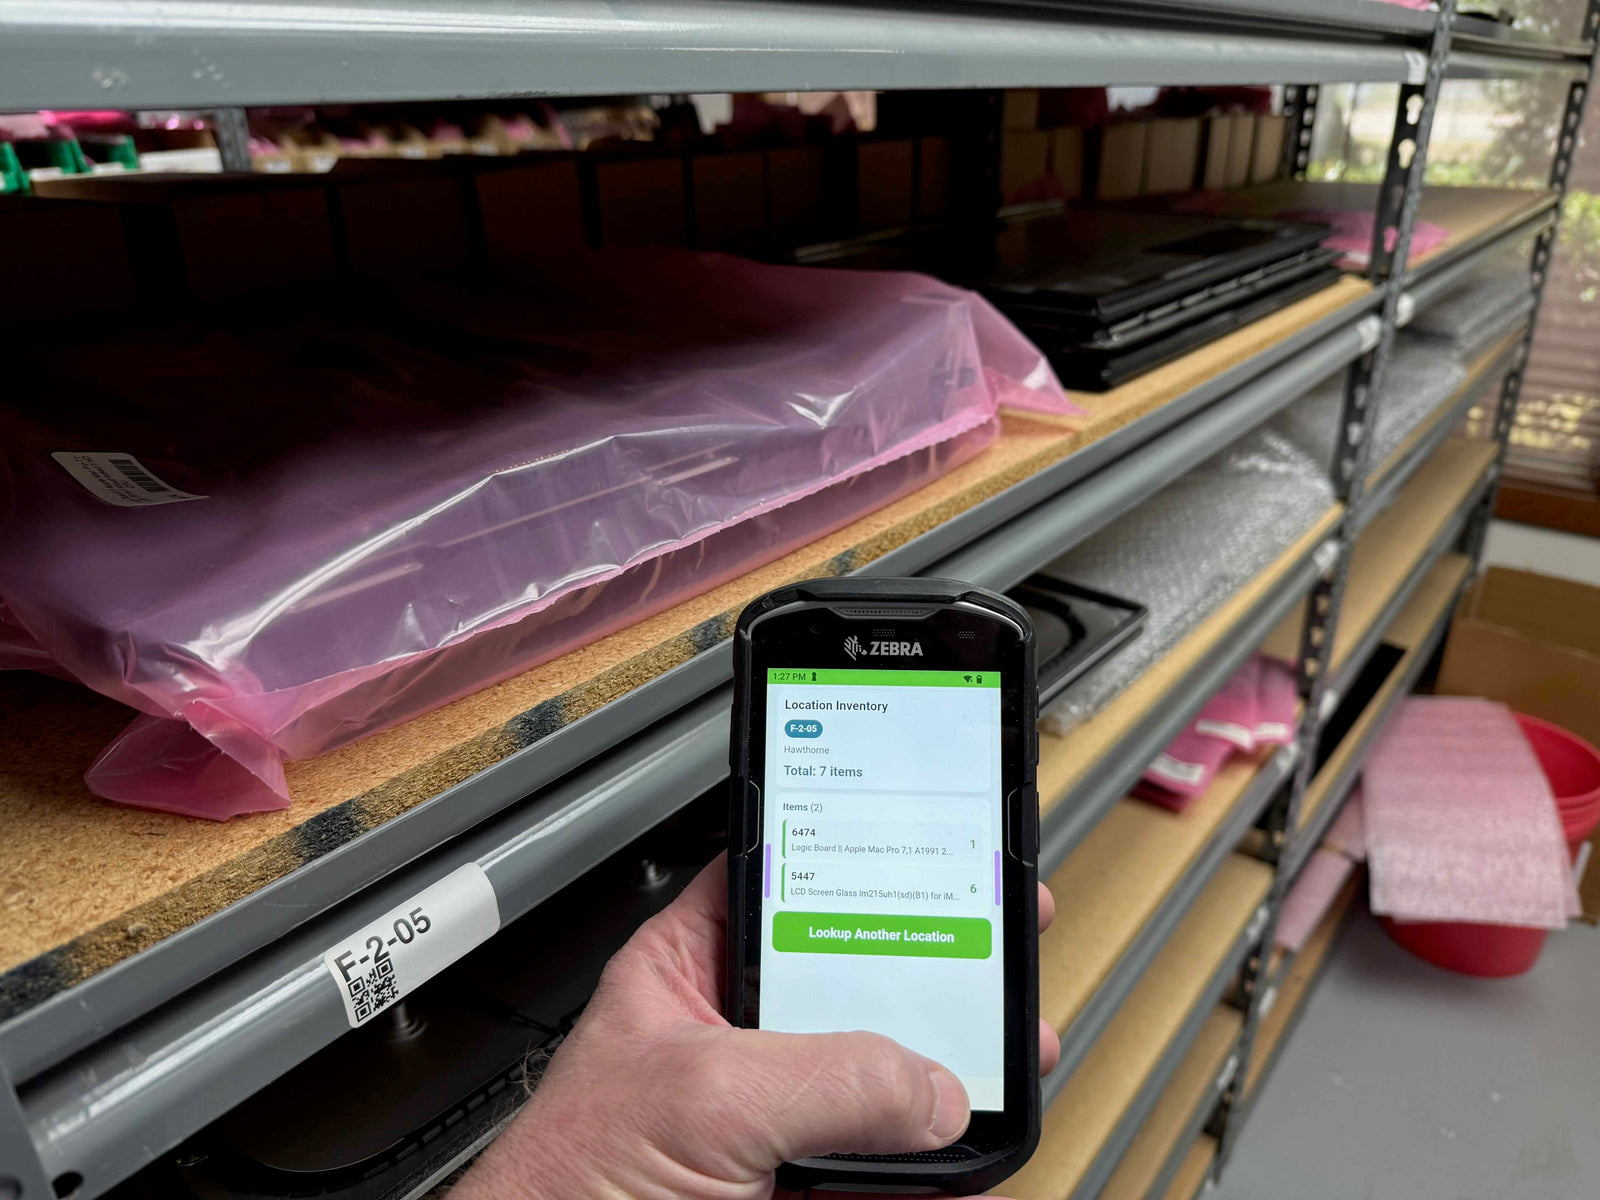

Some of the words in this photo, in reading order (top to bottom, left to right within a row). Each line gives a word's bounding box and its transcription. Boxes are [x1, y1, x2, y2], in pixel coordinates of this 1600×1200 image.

[869, 641, 923, 656] ZEBRA
[772, 672, 790, 681] 1:27
[792, 673, 806, 682] PM
[785, 700, 833, 711] Location
[836, 700, 888, 713] Inventory
[790, 724, 817, 733] F-2-05
[784, 745, 830, 755] Hawthorne
[784, 765, 816, 776] Total:
[819, 766, 827, 777] 7
[830, 766, 863, 777] items
[783, 803, 808, 812] Items
[810, 803, 823, 813] (2)
[791, 828, 816, 837] 6474
[791, 843, 812, 853] Logic
[814, 844, 836, 852] Board
[844, 845, 866, 855] Apple
[868, 846, 884, 854] Mac
[886, 846, 899, 854] Pro
[914, 847, 939, 855] A1991
[970, 840, 976, 849] 1
[791, 872, 815, 881] 5447
[790, 888, 806, 896] LCD
[808, 888, 834, 897] Screen
[836, 888, 858, 897] Glass
[930, 892, 942, 900] for
[970, 884, 977, 894] 6
[808, 926, 852, 941] Lookup
[854, 927, 901, 941] Another
[904, 929, 955, 943] Location
[334, 906, 432, 982] F-2-05
